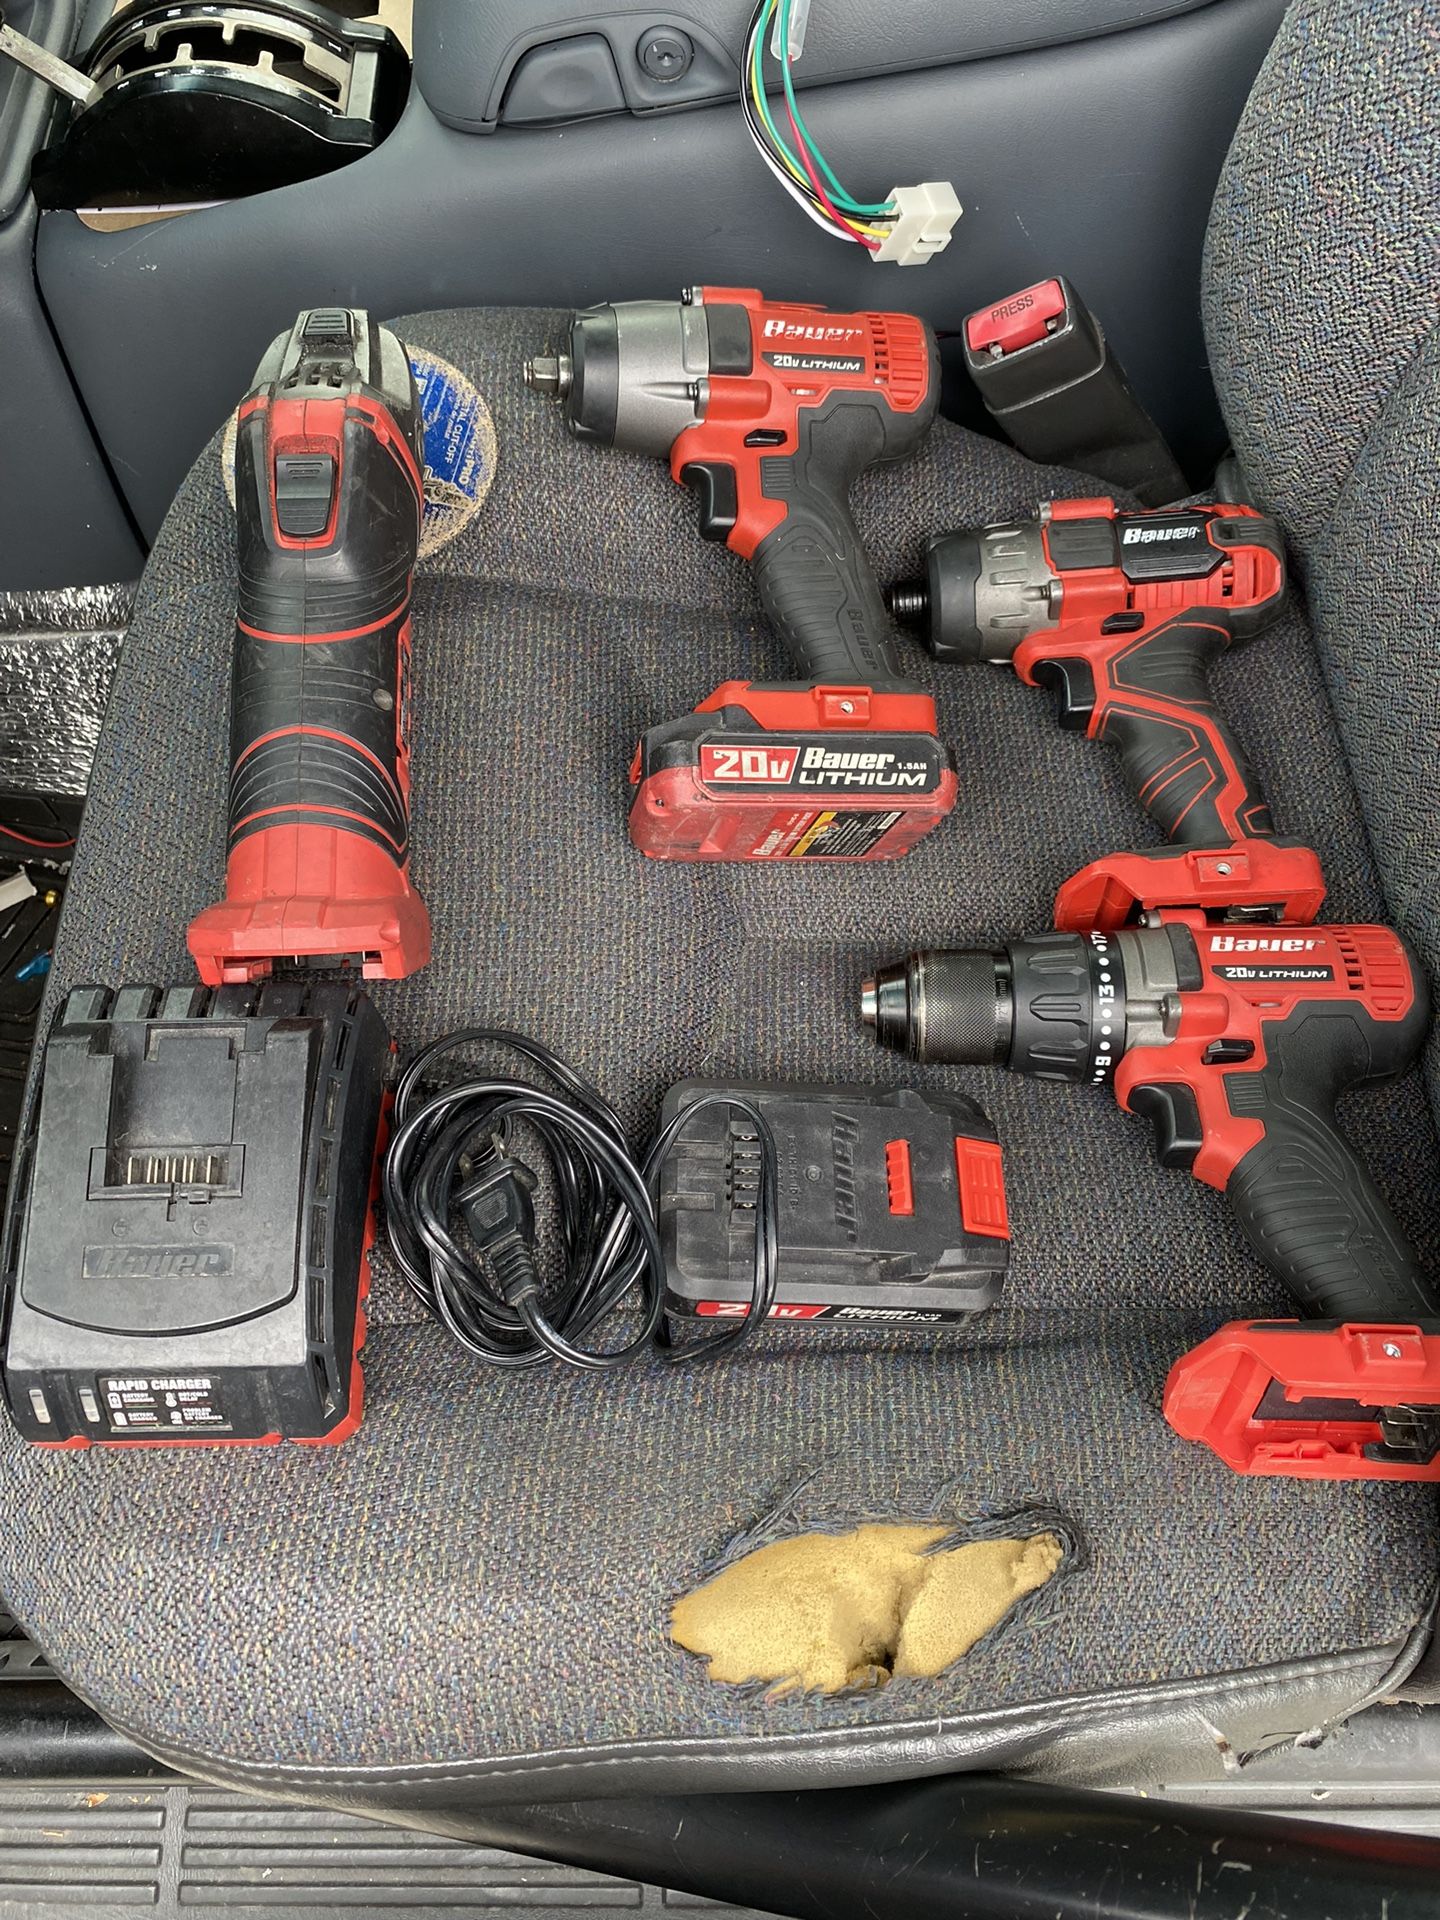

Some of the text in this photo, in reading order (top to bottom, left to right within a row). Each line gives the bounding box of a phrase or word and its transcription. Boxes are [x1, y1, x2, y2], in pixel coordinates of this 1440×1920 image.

[991, 294, 1034, 323] PRESS
[762, 319, 856, 340] Bauer
[801, 359, 860, 371] LITHIUM
[444, 424, 463, 464] CUT-OFF
[1123, 526, 1198, 544] Bauer
[802, 747, 894, 770] Bauer
[798, 772, 927, 786] LITHIUM
[1210, 936, 1318, 952] Bauer
[1259, 970, 1328, 978] LITHIUM
[1098, 984, 1115, 1005] 13
[108, 1379, 212, 1392] RAPID CHARGER
